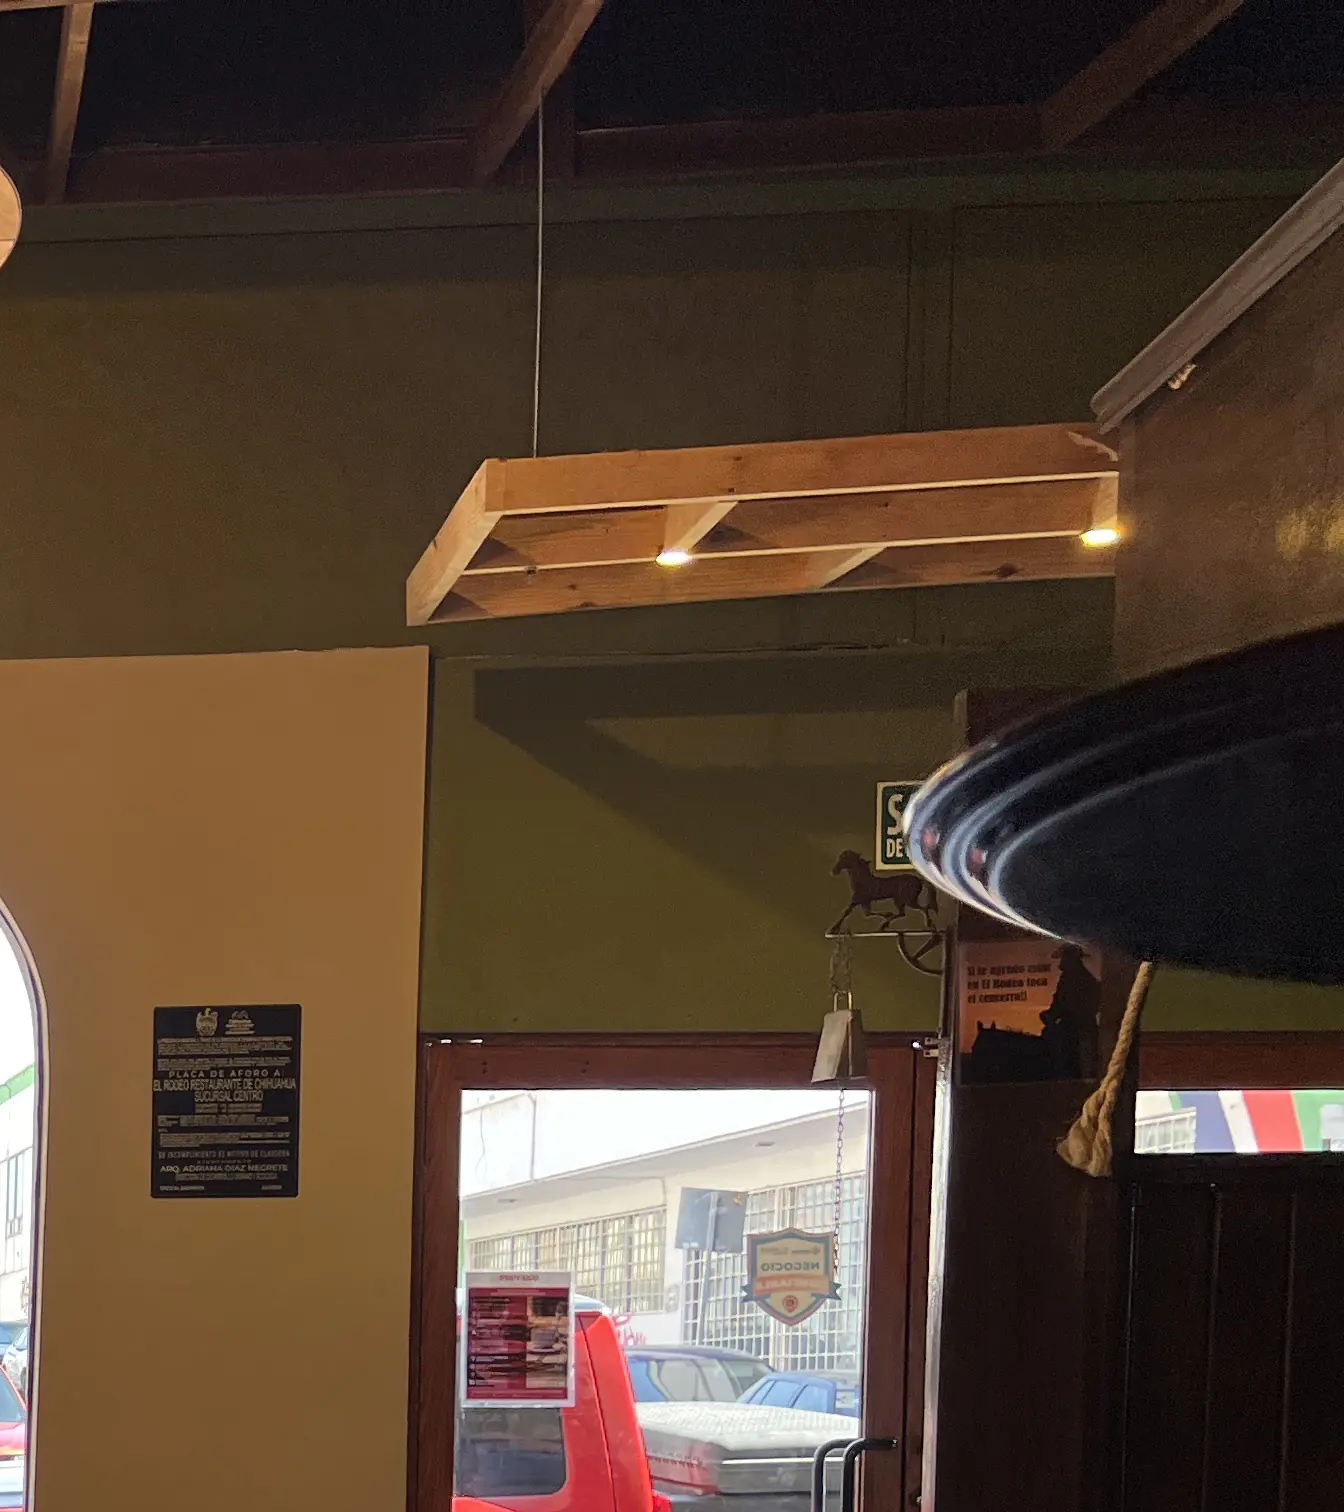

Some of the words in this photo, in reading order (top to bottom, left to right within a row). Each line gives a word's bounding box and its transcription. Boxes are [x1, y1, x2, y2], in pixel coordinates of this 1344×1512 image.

[886, 838, 903, 858] DE
[168, 1070, 205, 1078] PLACA
[229, 1069, 269, 1077] AFORO
